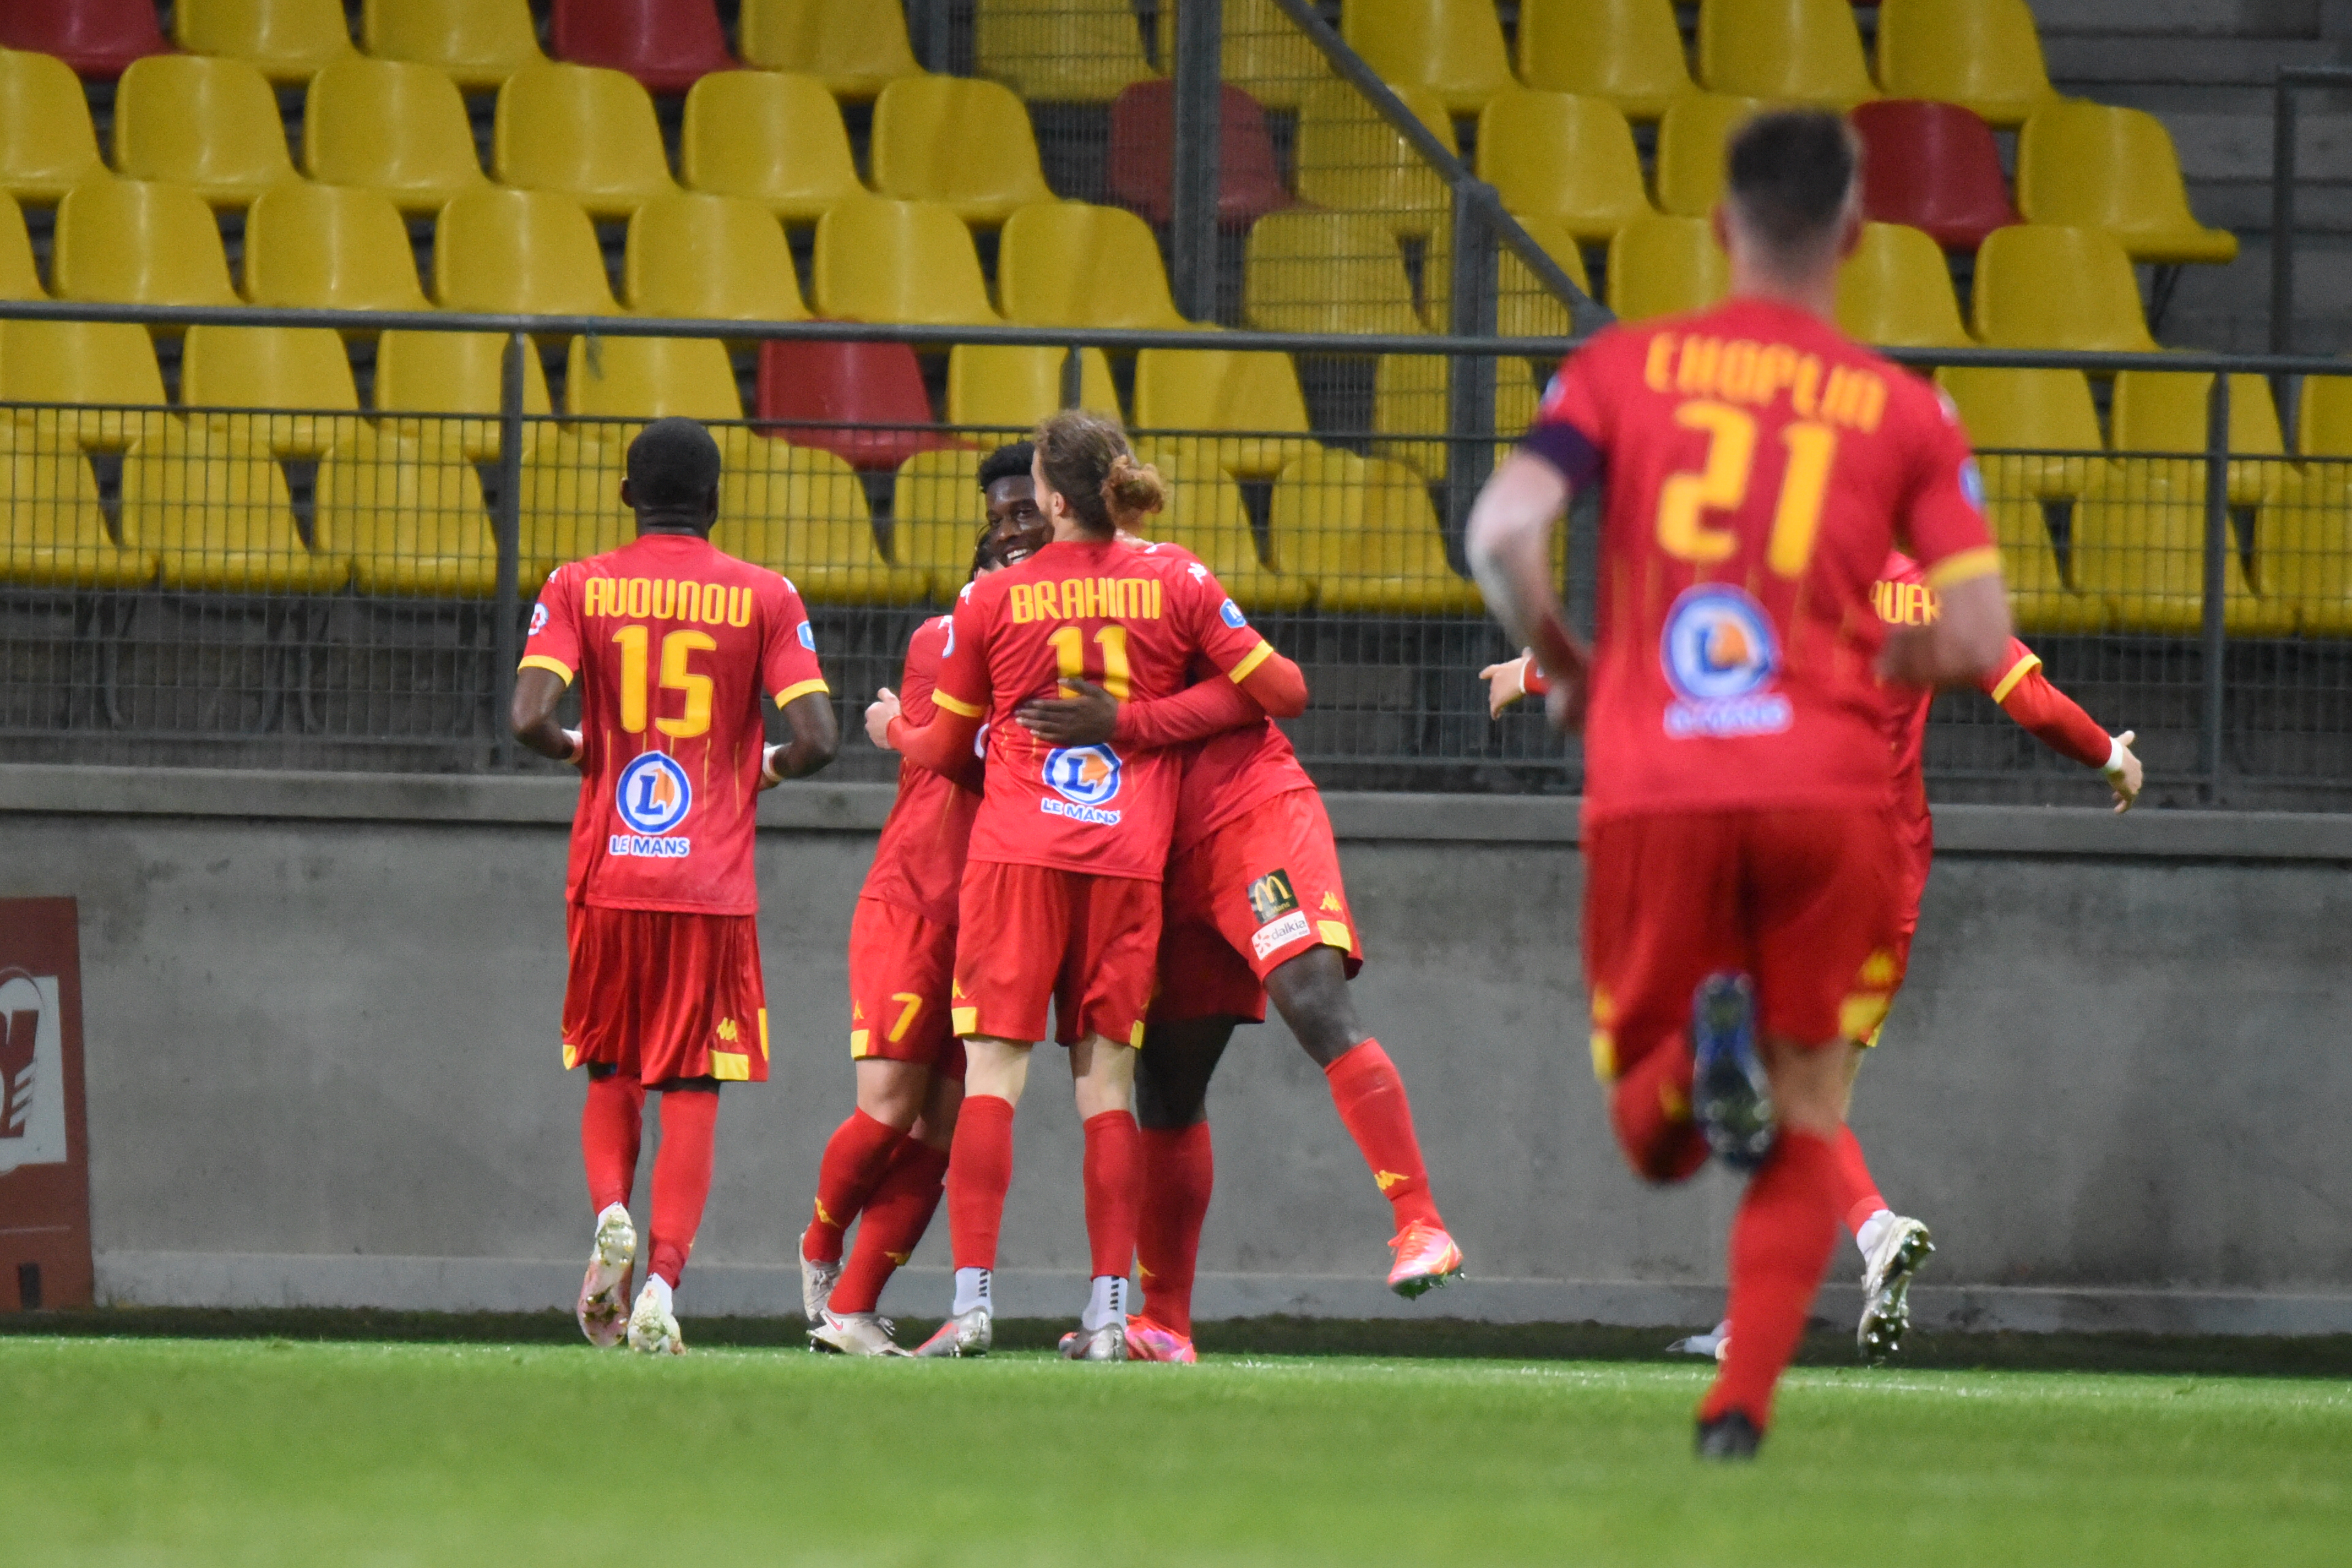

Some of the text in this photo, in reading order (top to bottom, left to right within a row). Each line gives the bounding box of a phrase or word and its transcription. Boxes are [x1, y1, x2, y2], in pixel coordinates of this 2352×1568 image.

[1657, 400, 1836, 579] 21
[1009, 577, 1161, 624] BRAHIMI
[612, 625, 717, 738] 15
[1047, 625, 1129, 703] 11
[1042, 799, 1118, 823] LE MANS
[612, 837, 688, 855] LE MANS
[1272, 919, 1306, 940] dalkia
[889, 993, 922, 1042] 7
